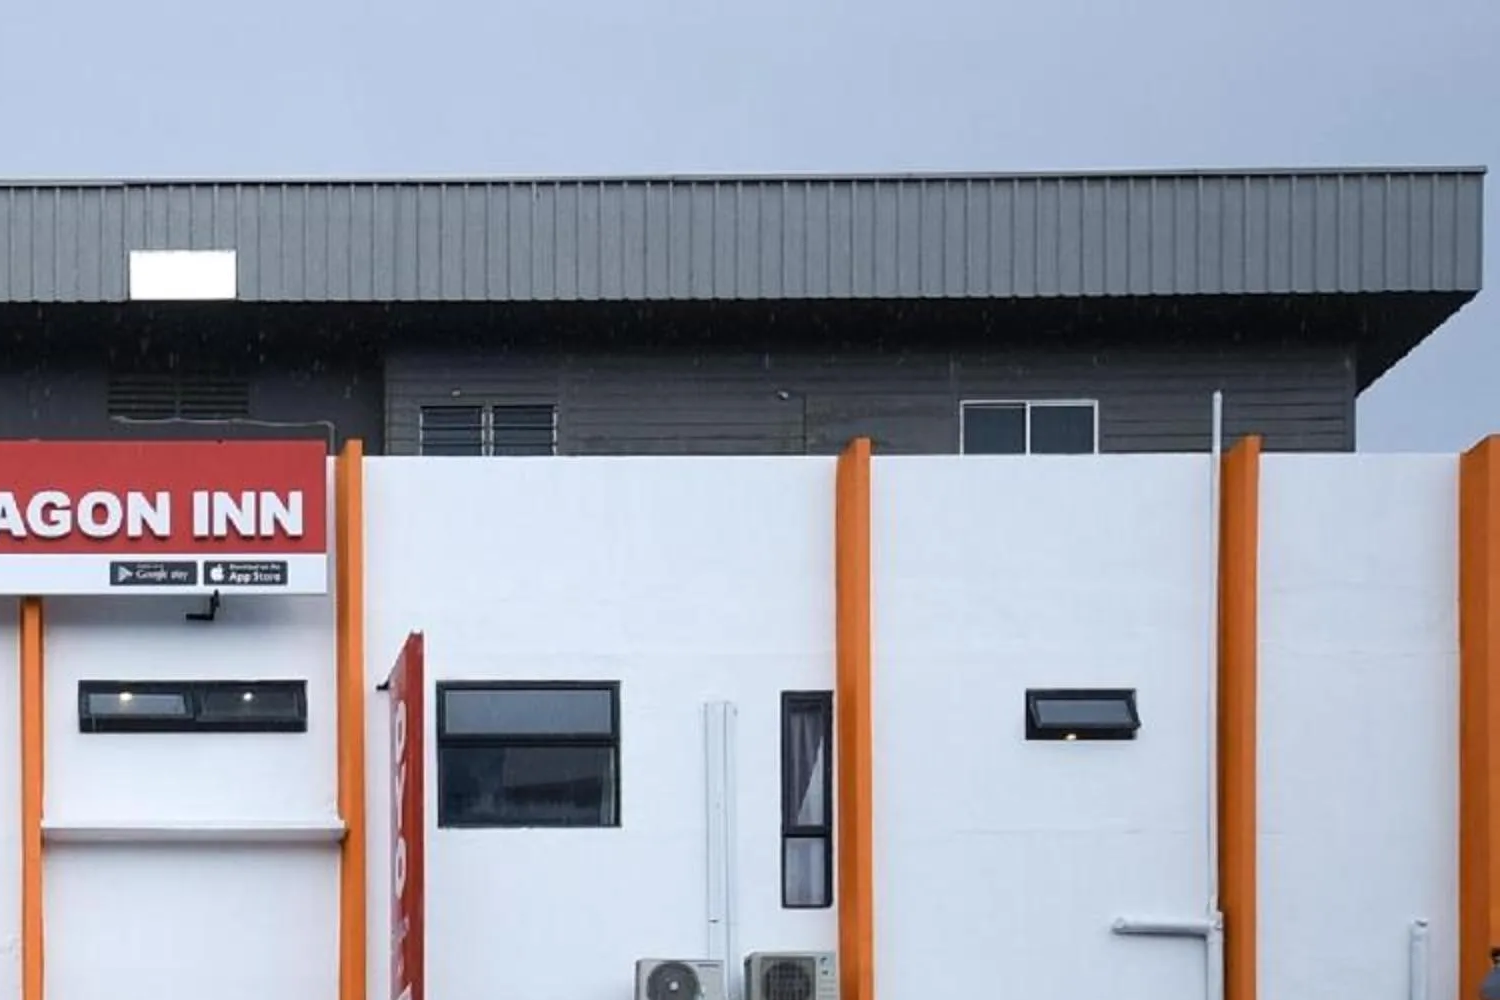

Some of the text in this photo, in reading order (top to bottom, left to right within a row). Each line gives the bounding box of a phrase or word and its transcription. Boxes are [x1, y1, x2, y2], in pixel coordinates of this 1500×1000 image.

[192, 491, 303, 538] INN
[228, 571, 281, 583] App Store
[394, 700, 407, 900] OYO
